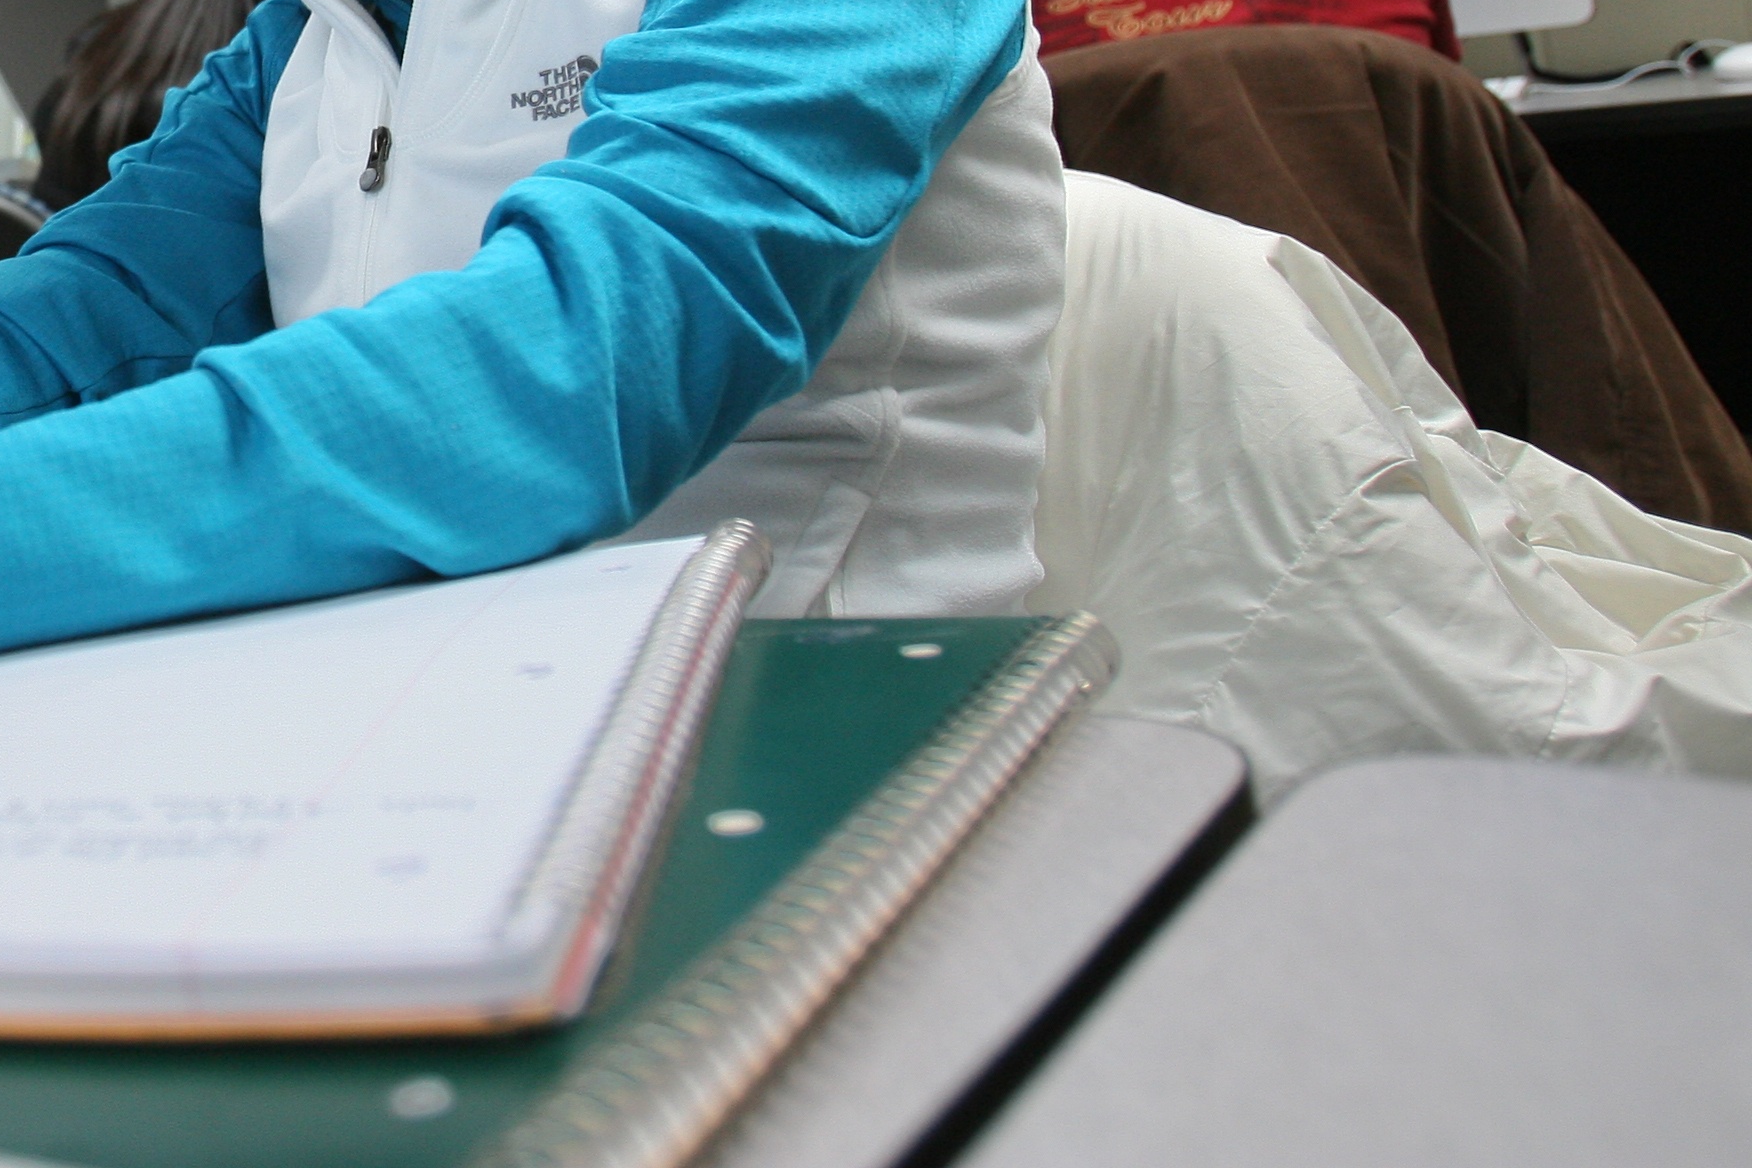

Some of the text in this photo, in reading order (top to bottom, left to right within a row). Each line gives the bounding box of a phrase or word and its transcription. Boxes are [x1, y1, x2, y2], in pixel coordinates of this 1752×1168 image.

[539, 60, 578, 86] THE
[511, 77, 581, 109] NORTH
[532, 93, 580, 122] FACE
